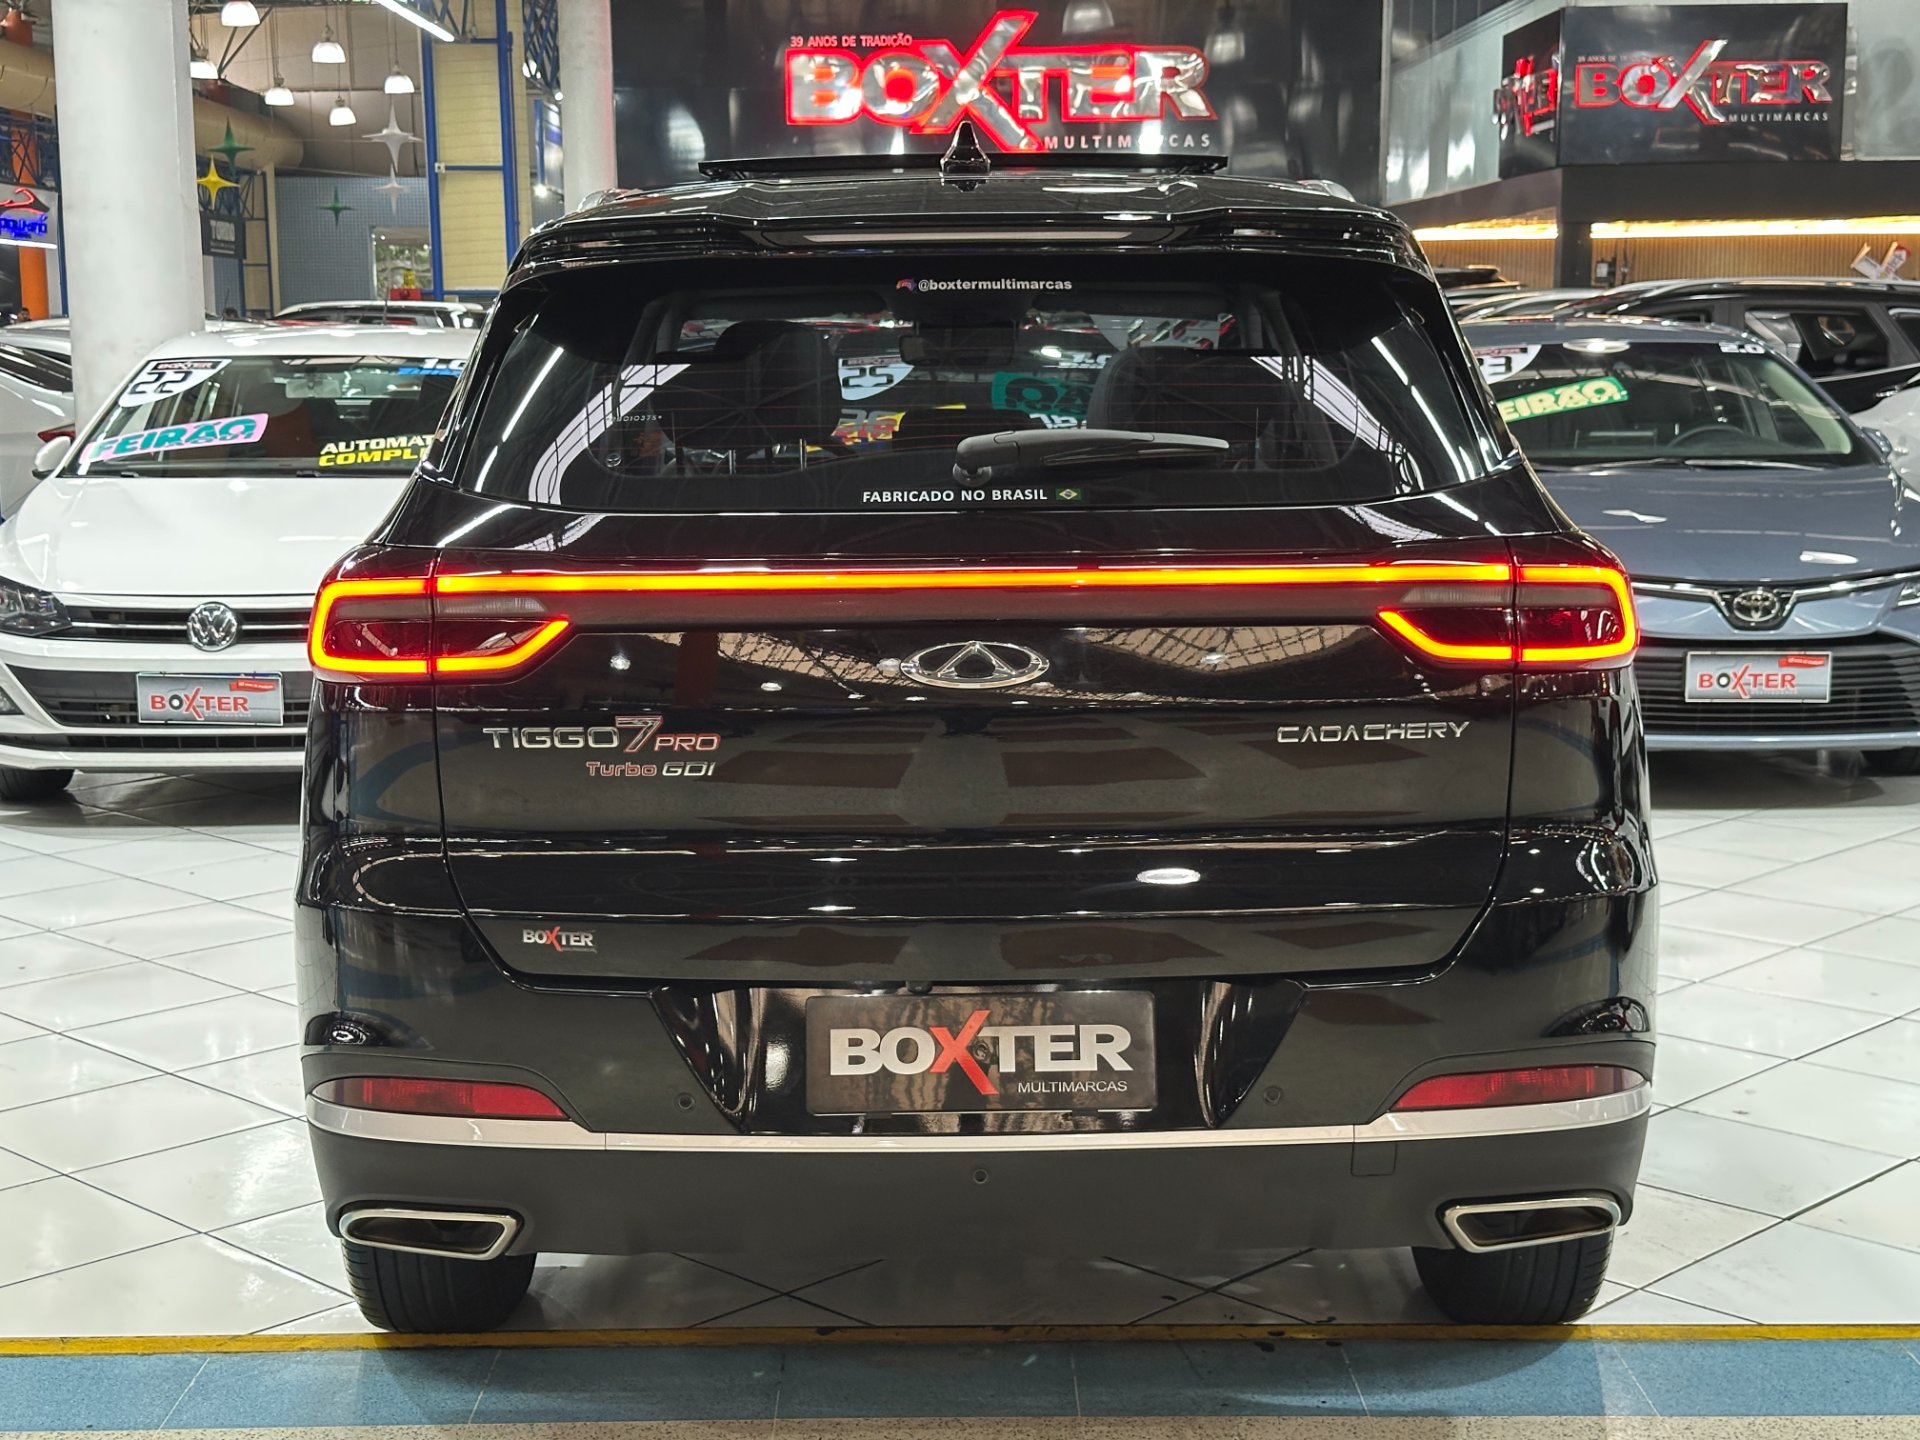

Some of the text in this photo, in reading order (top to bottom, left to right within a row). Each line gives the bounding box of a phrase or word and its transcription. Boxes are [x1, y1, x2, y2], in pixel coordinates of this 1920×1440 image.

[790, 32, 912, 47] 39 ANOS DE TRADIÇÃO
[786, 9, 1217, 152] BOXTER
[1574, 39, 1833, 125] BOXTER
[1728, 112, 1828, 123] MULTIMARCAS
[1044, 134, 1211, 149] MULTIMCAS
[918, 278, 1073, 292] @boxtermultimarcas
[129, 370, 193, 394] 22
[90, 417, 257, 460] FEIRÃO
[862, 489, 1048, 503] FABRICADO NO BRASIL
[1697, 664, 1797, 698] BOXTER
[150, 687, 250, 720] BOXTER
[654, 733, 721, 752] PRO
[586, 761, 657, 777] Turbo
[522, 926, 594, 951] BOXTER
[830, 1009, 1134, 1095] BOXTER
[1017, 1079, 1128, 1093] MULTIMARCAS
